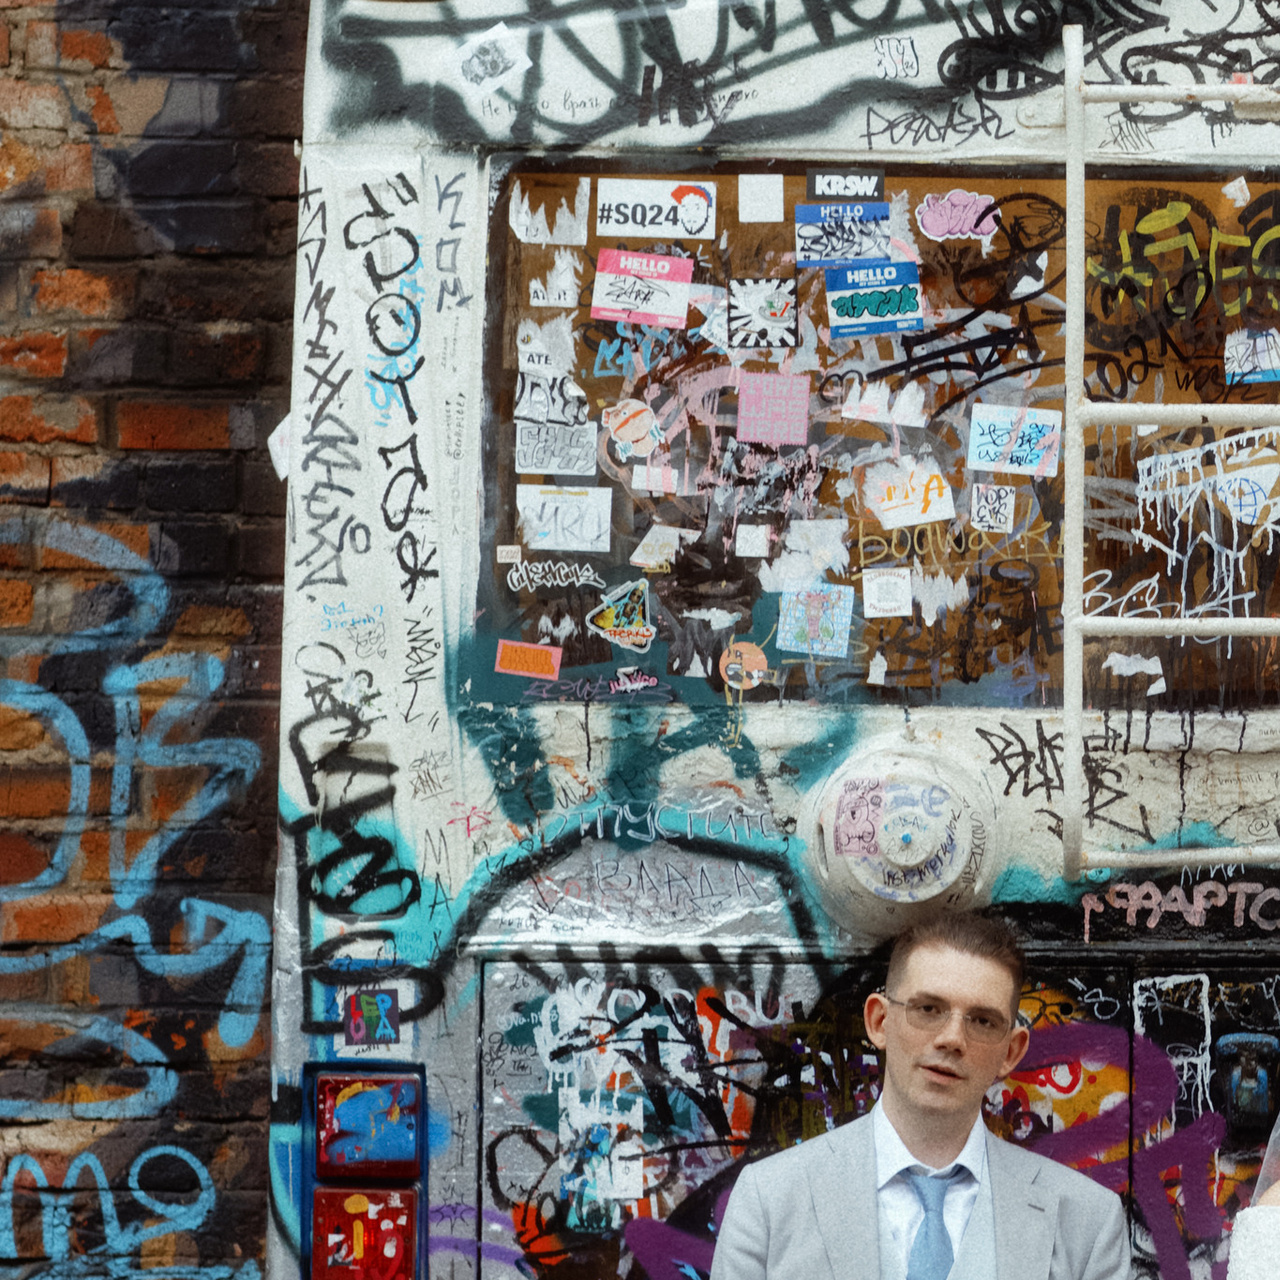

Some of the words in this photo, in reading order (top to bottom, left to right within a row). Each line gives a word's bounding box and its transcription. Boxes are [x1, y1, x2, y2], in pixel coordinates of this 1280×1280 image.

[815, 174, 879, 197] KRSW.
[598, 203, 680, 226] #SQ24
[820, 205, 864, 219] HELLO
[619, 256, 671, 274] HELLO
[846, 266, 897, 284] HELLO
[527, 354, 552, 365] ATE
[595, 859, 762, 902] ВЛАДА
